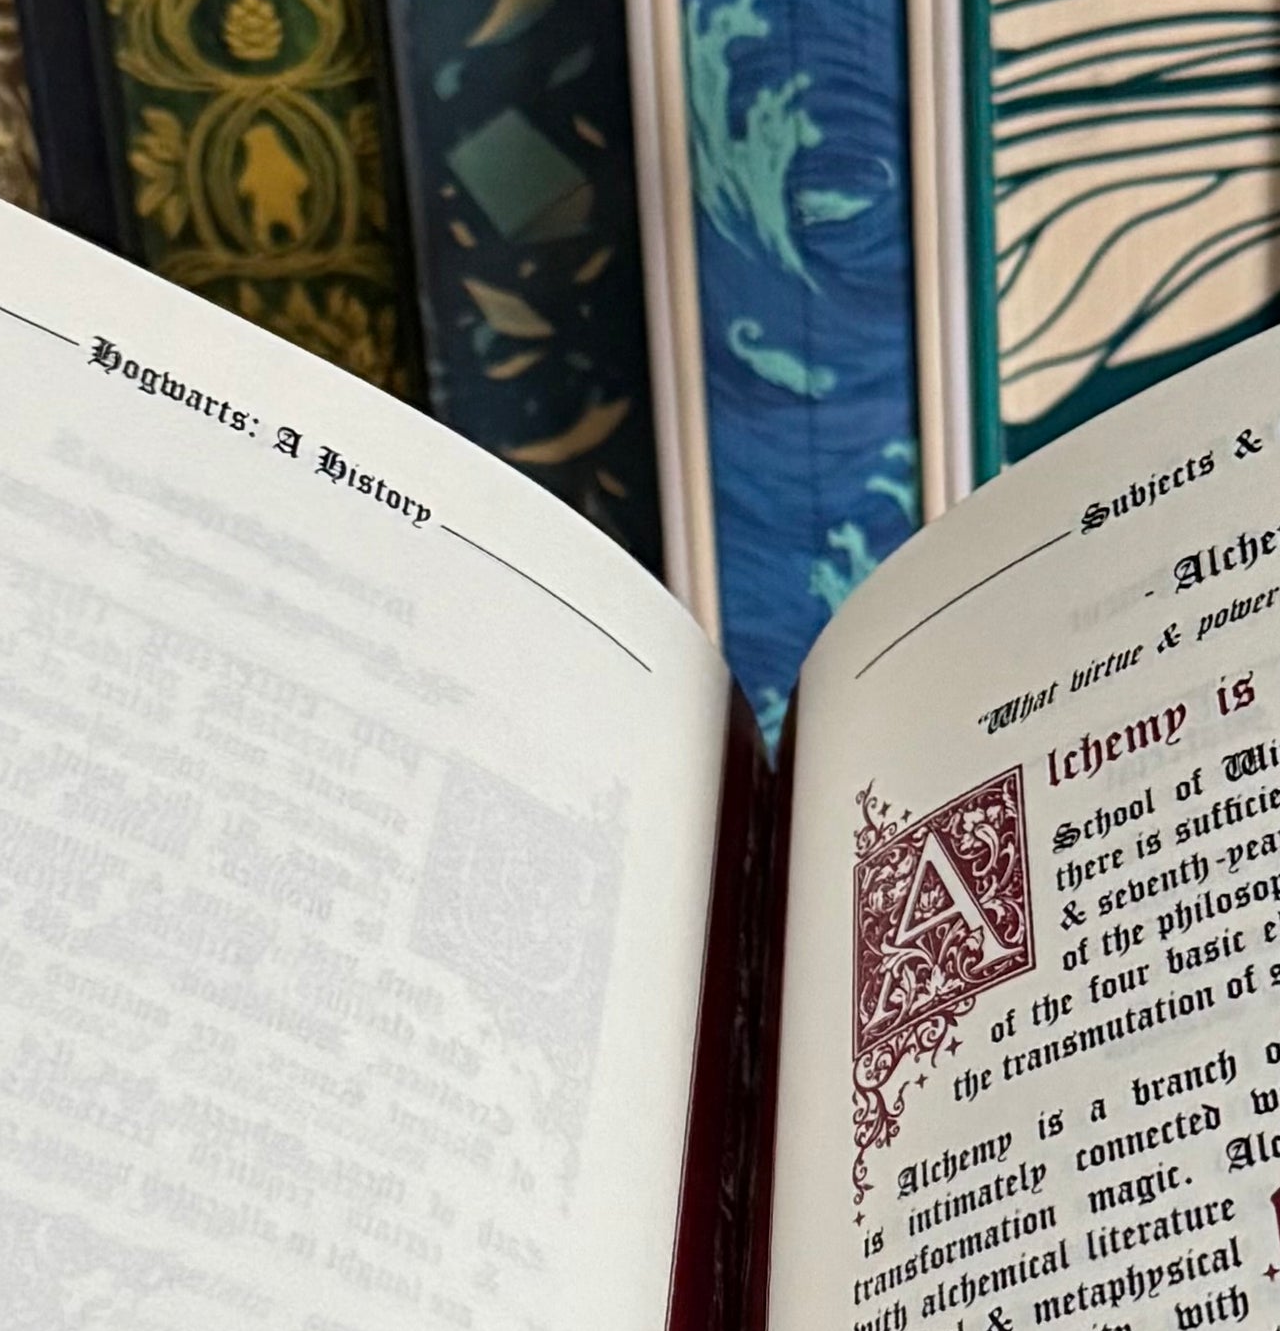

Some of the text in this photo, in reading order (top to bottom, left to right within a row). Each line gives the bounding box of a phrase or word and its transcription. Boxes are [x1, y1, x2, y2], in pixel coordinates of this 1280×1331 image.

[86, 335, 432, 529] Hogwarts: A History
[1080, 449, 1215, 536] Subjects
[1233, 428, 1264, 460] &
[1069, 644, 1144, 693] virtue
[1156, 622, 1182, 654] &
[1195, 586, 1280, 642] power
[1216, 670, 1256, 717] is
[1052, 786, 1156, 855] School
[1175, 767, 1204, 802] of
[1059, 899, 1088, 932] &
[990, 1008, 1017, 1044] of
[1031, 993, 1073, 1027] the
[1087, 963, 1150, 1004] four
[1165, 930, 1247, 975] basic
[896, 1131, 1013, 1201] Alchemy
[1037, 1108, 1064, 1141] is
[1090, 1098, 1108, 1123] a
[1131, 1048, 1237, 1107] branch
[863, 1226, 885, 1259] is
[908, 1161, 1047, 1238] intimately
[1075, 1103, 1222, 1172] connected
[1033, 1235, 1243, 1326] metaphysical
